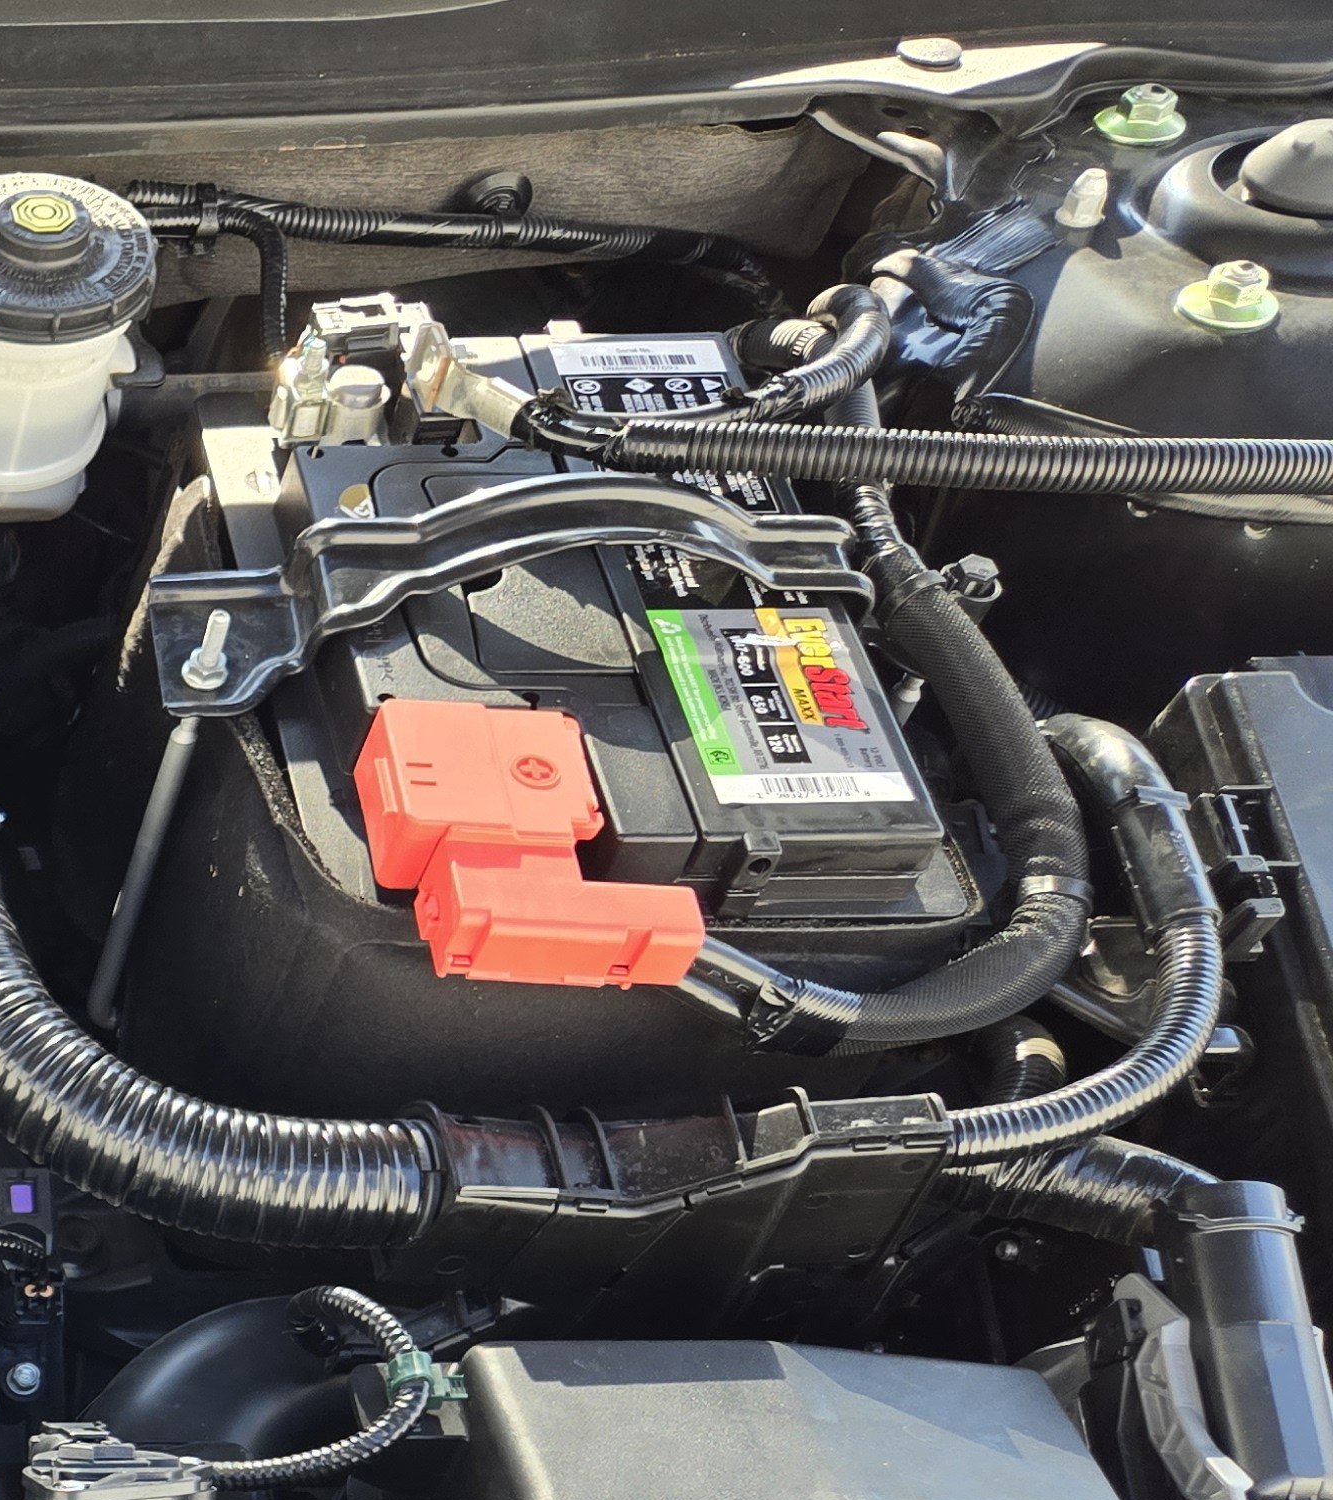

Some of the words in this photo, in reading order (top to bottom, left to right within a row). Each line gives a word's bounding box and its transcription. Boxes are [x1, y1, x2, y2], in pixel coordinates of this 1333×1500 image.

[783, 617, 870, 732] EverStart
[749, 694, 767, 715] 650
[793, 686, 817, 722] MAXX
[766, 733, 785, 754] 120
